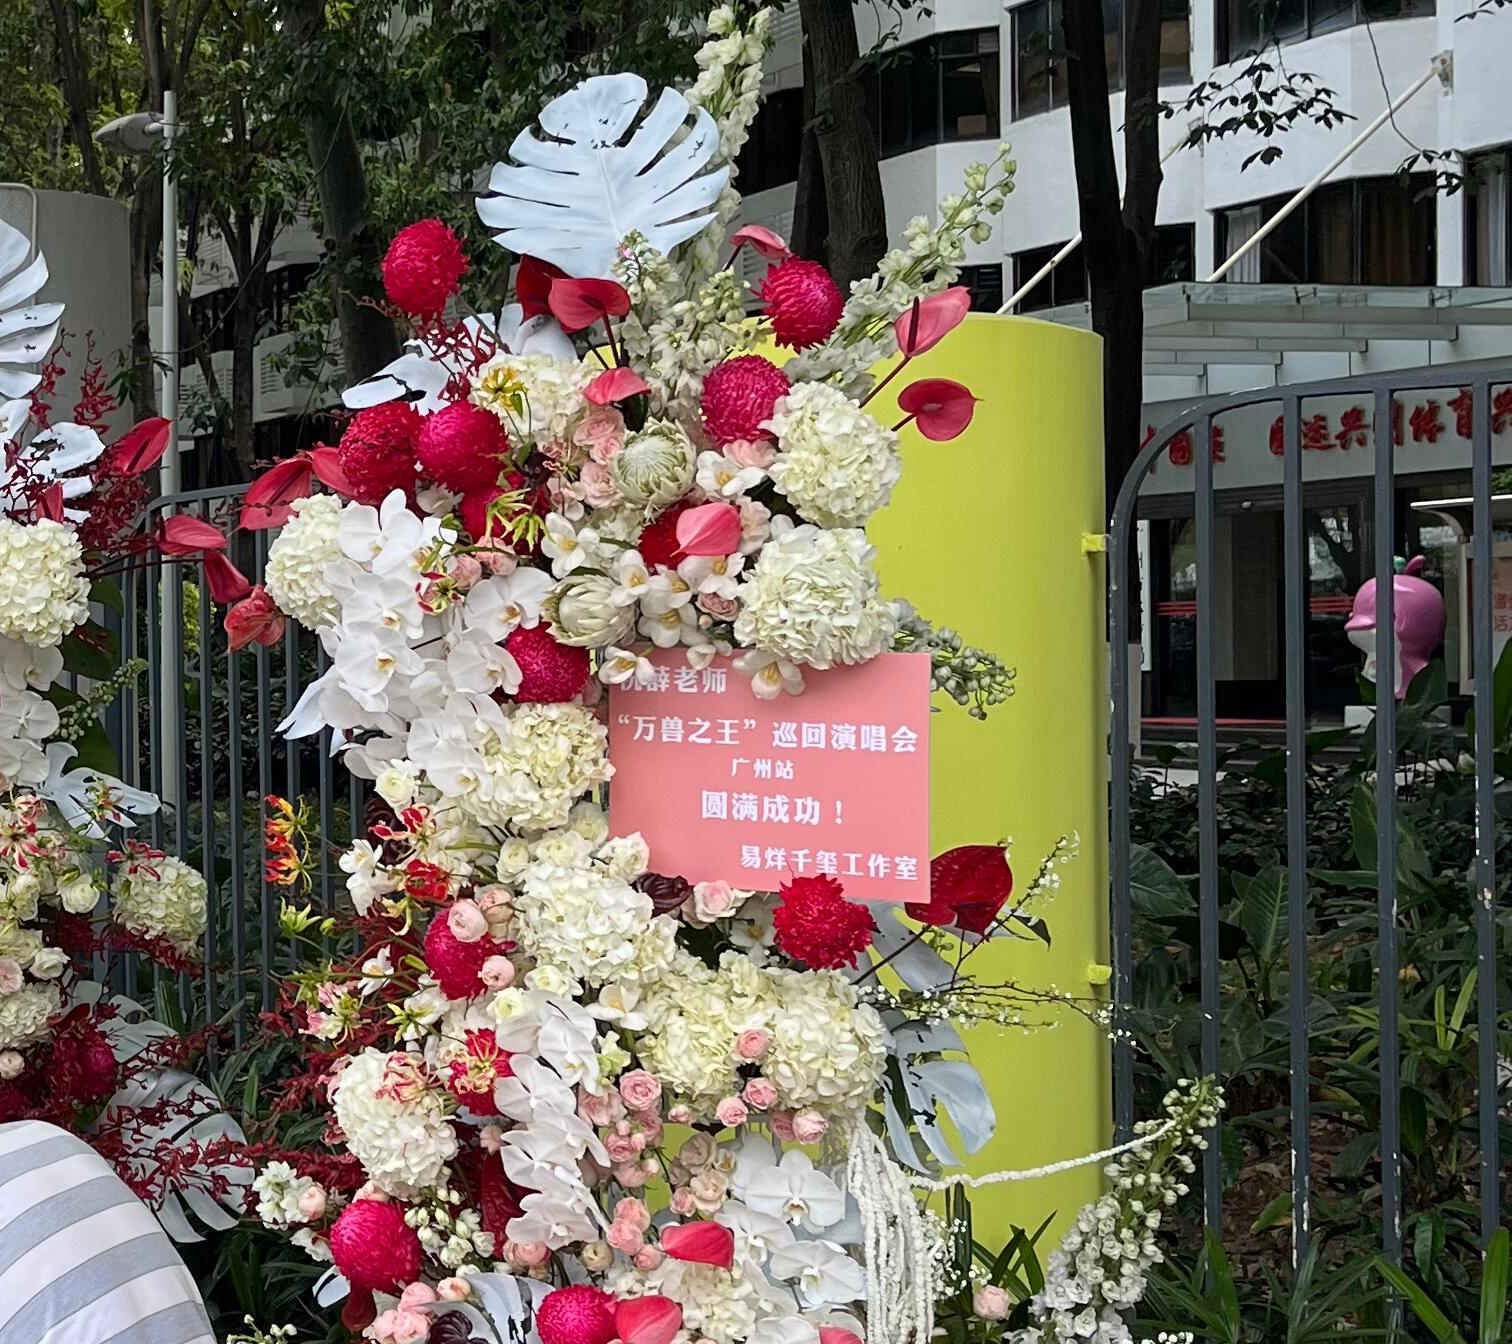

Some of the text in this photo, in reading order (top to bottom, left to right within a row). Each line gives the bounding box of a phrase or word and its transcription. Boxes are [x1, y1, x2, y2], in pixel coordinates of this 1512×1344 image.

[618, 714, 918, 753] “万兽之王” 巡回演唱会
[730, 757, 795, 780] 广州站
[701, 790, 843, 826] 圆满成功！
[740, 844, 918, 881] 易烊千玺工作室
